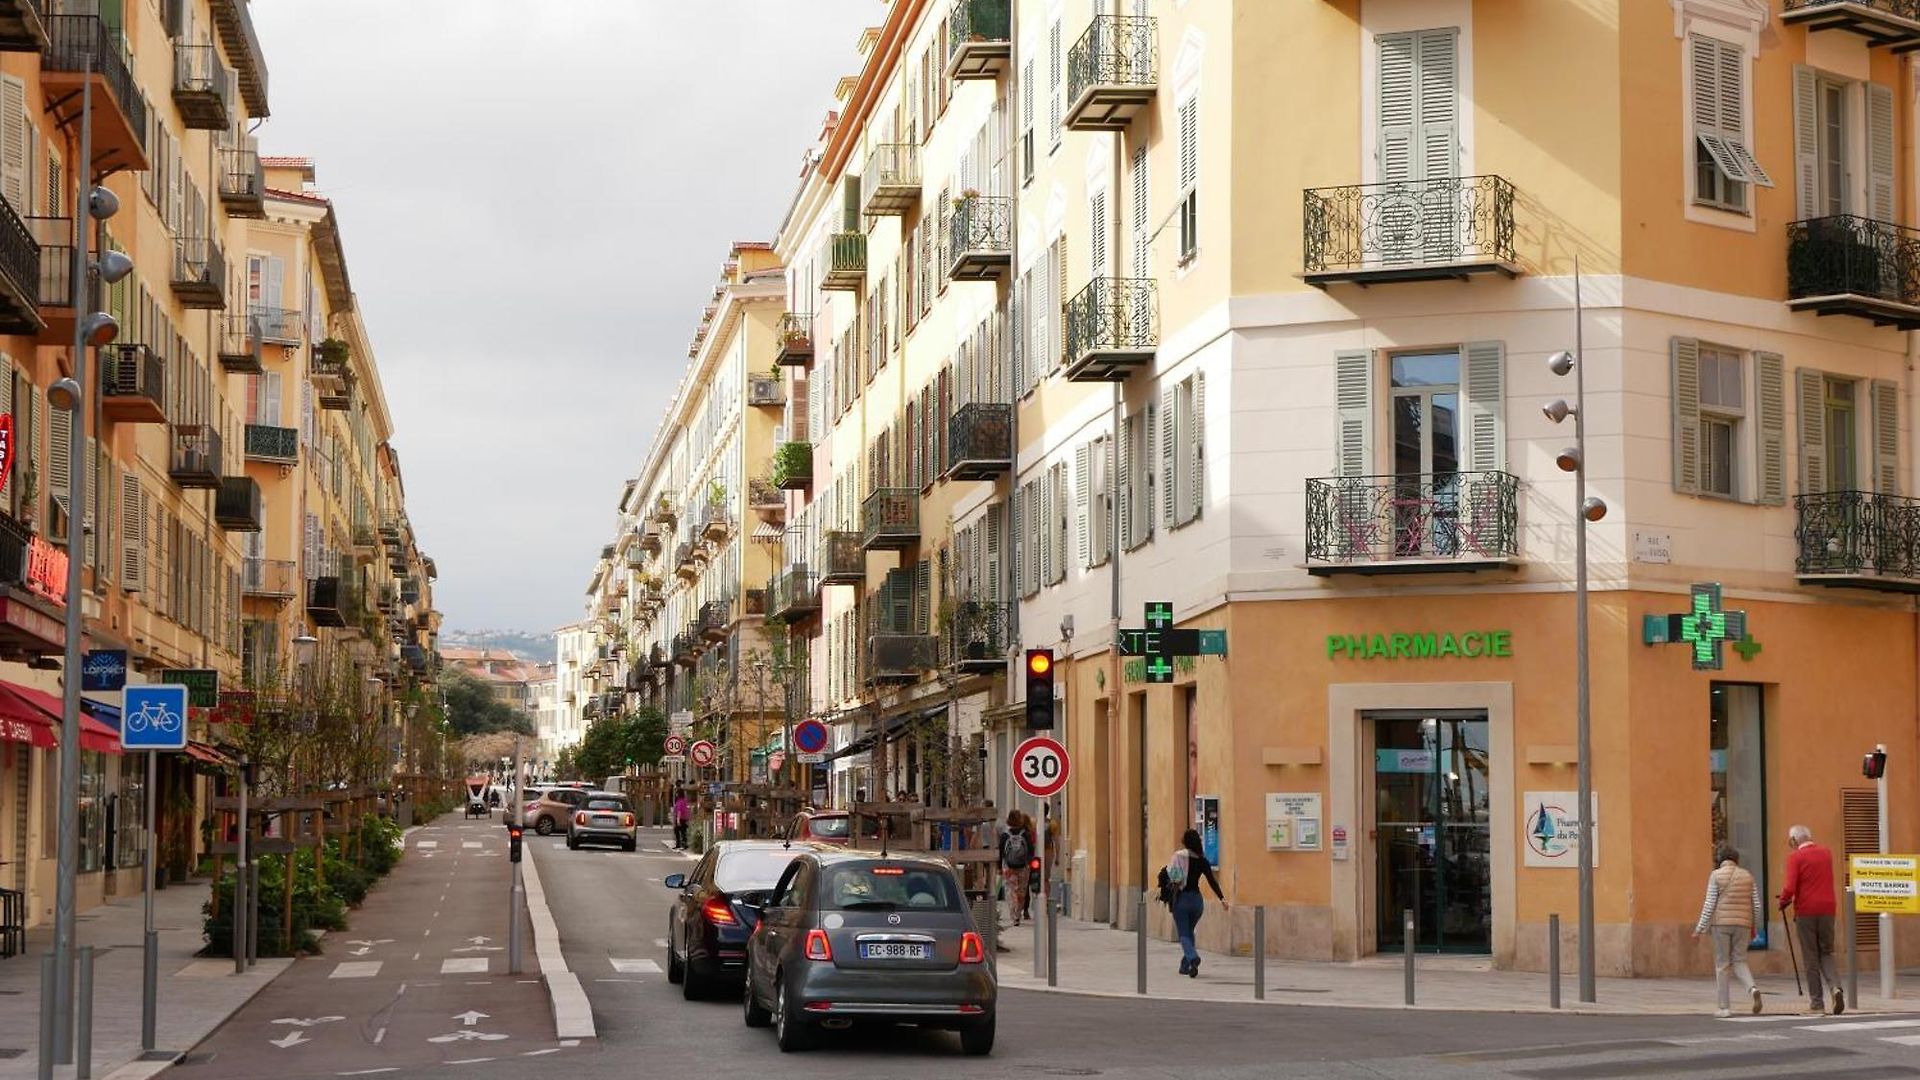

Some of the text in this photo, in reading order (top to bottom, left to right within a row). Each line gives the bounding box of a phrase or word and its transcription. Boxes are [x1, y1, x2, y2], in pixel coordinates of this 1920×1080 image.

[1326, 630, 1513, 661] PHARMACIE
[670, 741, 681, 750] 30
[1024, 755, 1059, 779] 30
